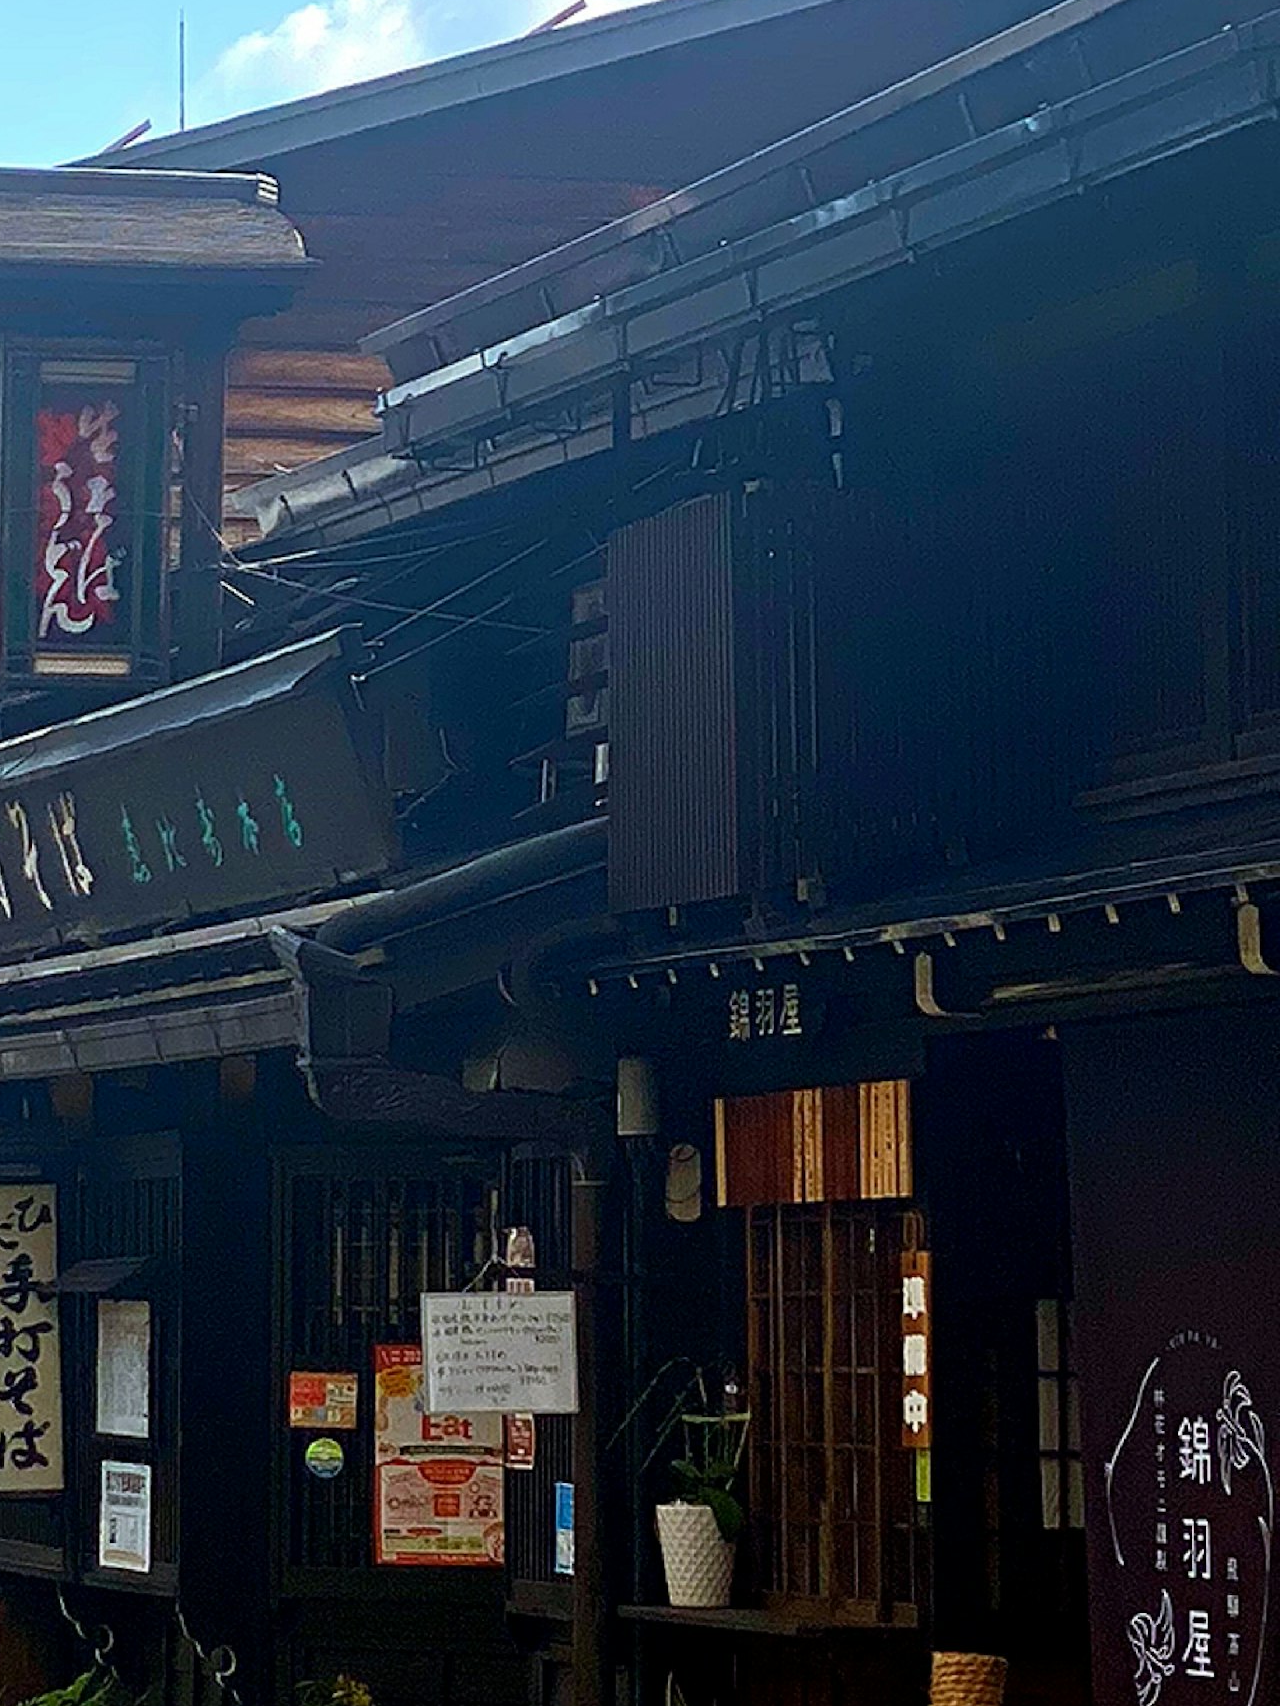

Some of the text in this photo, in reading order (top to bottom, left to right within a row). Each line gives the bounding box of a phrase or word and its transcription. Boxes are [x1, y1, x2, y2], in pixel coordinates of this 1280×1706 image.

[39, 461, 95, 638] うどん
[728, 984, 803, 1041] 錦羽屋
[1177, 1413, 1216, 1679] 錦羽屋
